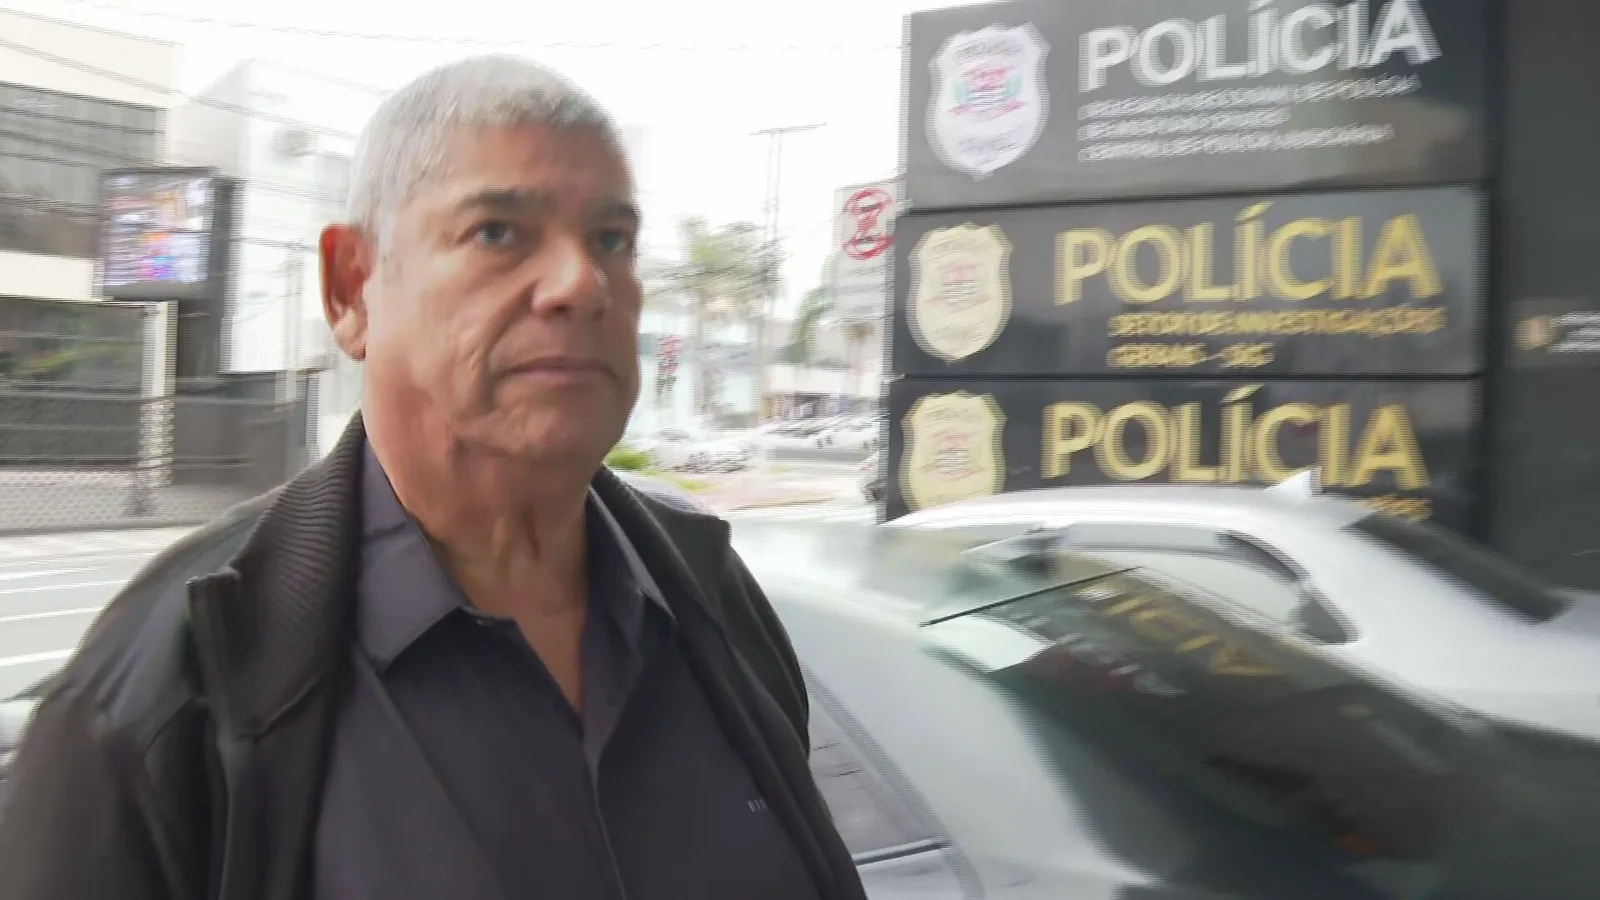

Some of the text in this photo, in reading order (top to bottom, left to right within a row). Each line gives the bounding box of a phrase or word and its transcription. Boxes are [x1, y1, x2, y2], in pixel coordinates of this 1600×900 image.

[1078, 0, 1443, 93] POLÍCIA
[1054, 201, 1444, 305] POLÍCIA
[1040, 383, 1430, 490] POLÍCIA
